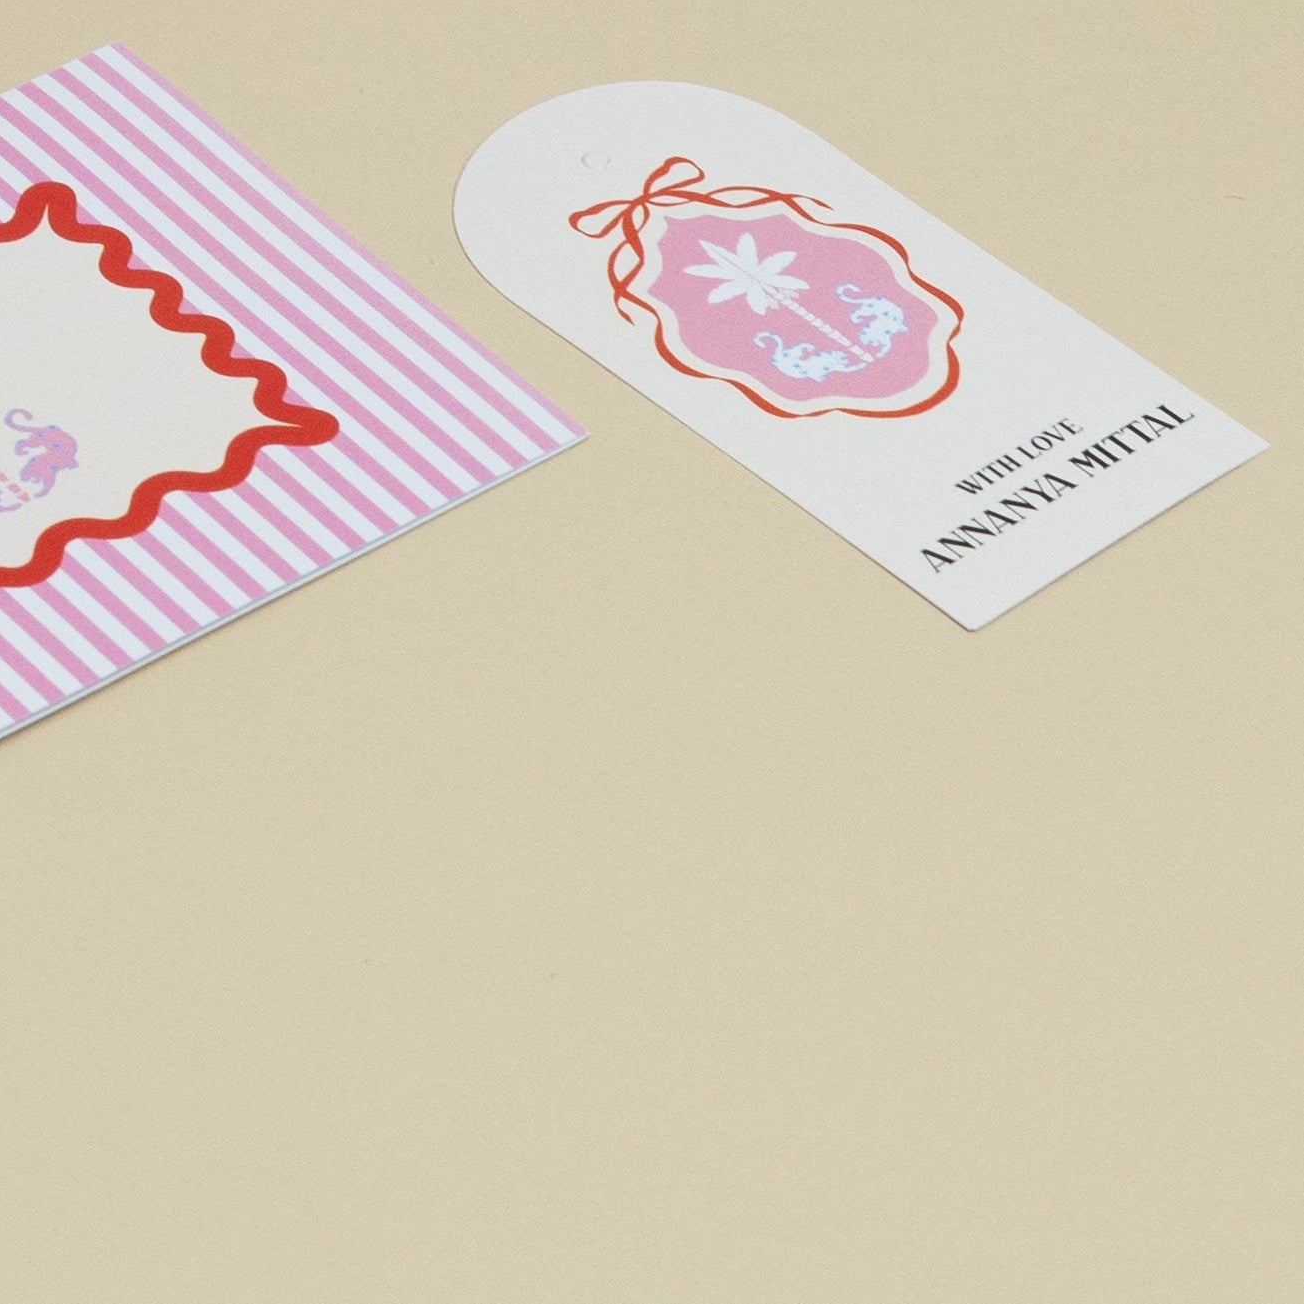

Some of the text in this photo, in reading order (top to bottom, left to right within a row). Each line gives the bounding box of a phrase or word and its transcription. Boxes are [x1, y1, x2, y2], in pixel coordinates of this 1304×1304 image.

[920, 404, 1195, 573] ANNANYA MITTAL
[954, 417, 1084, 496] WITH LOVE
